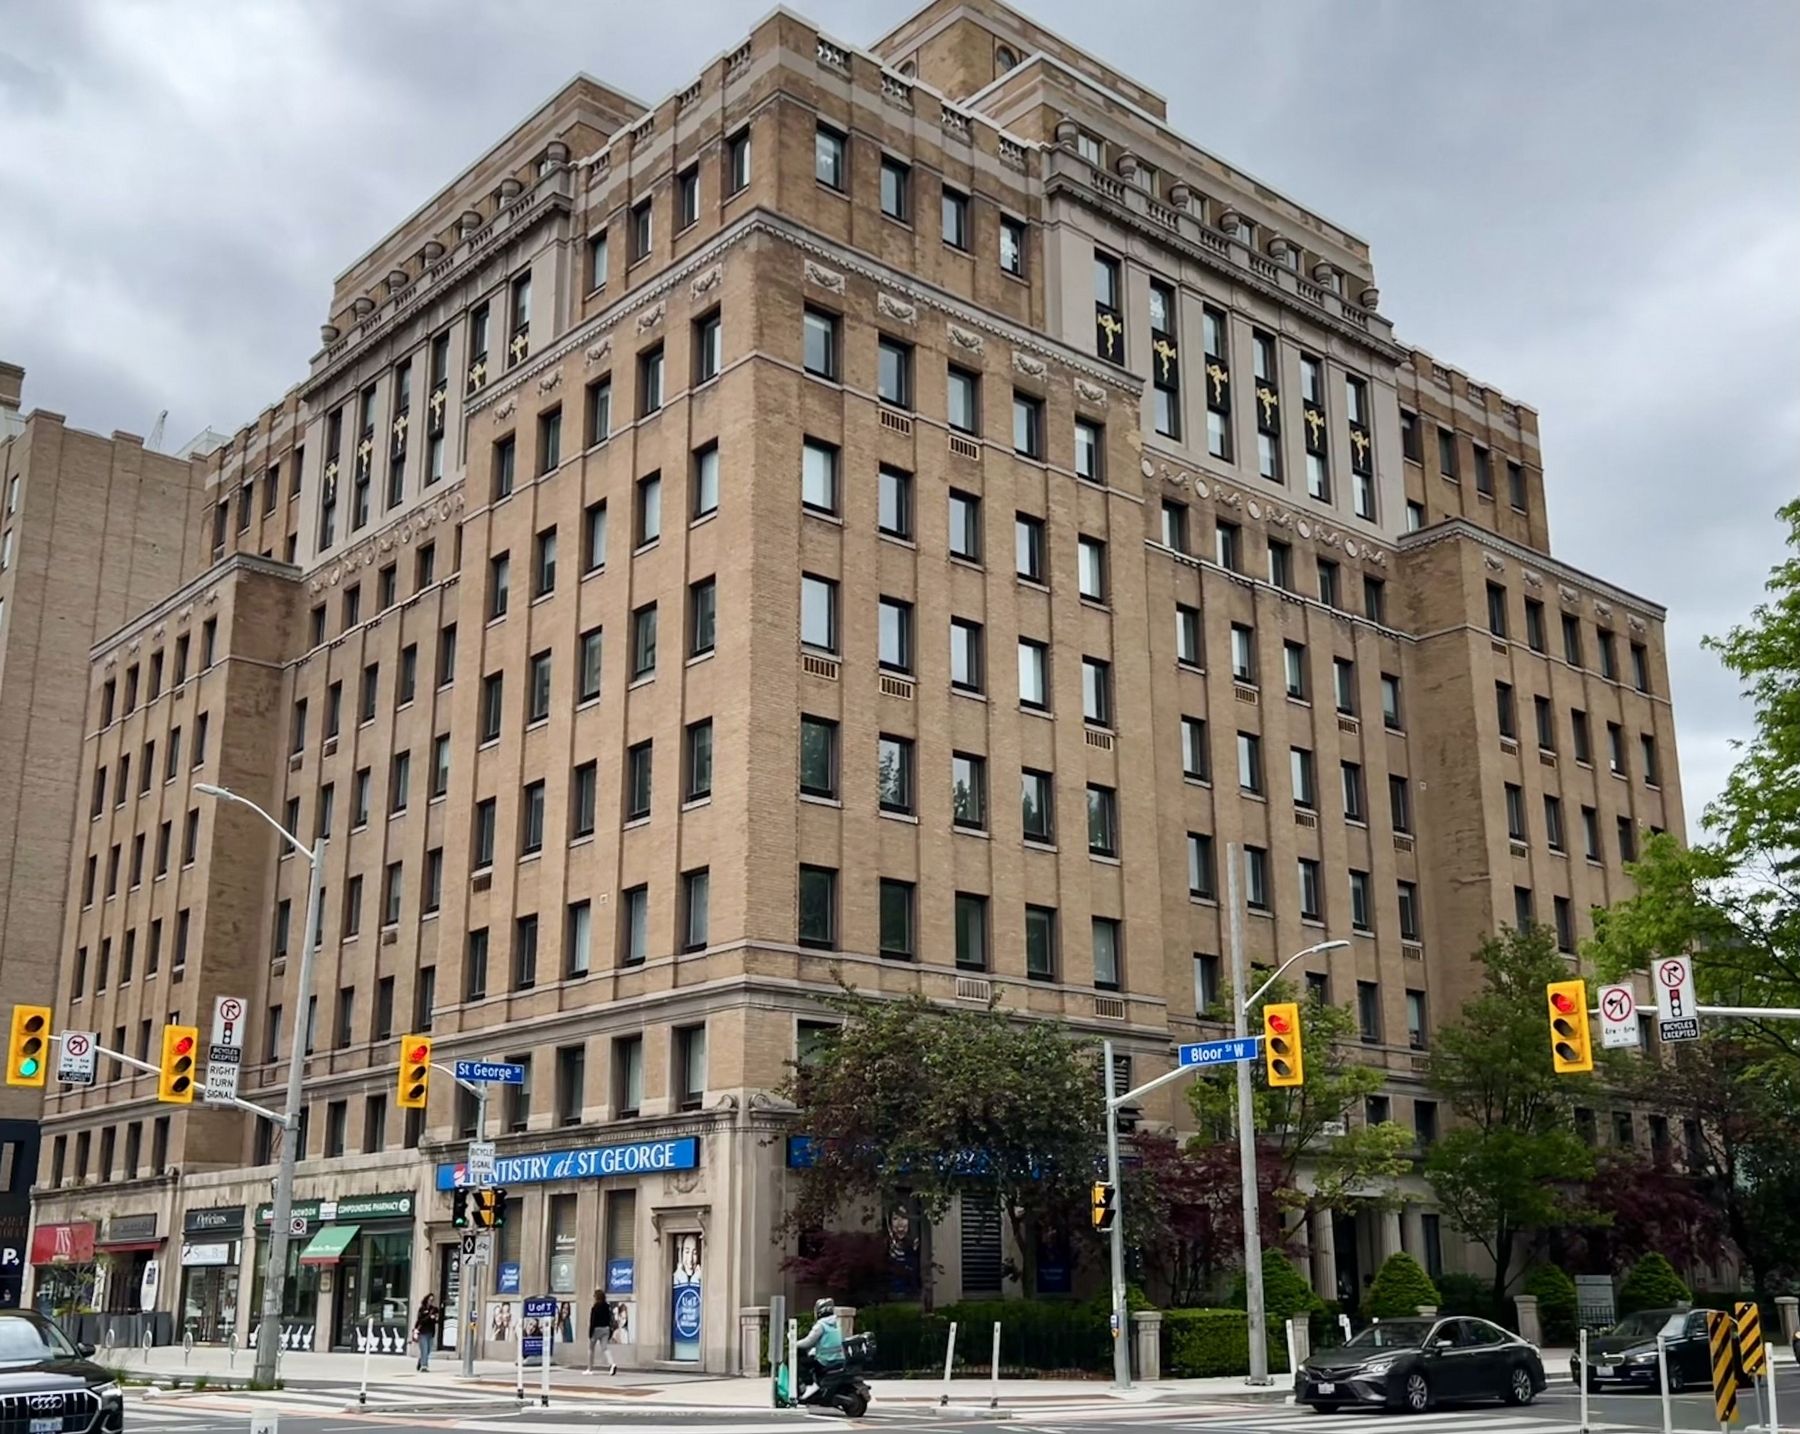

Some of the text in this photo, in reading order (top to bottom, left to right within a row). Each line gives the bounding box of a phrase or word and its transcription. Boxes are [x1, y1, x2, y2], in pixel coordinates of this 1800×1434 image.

[1663, 1021, 1694, 1031] BICYCLES
[1663, 1029, 1697, 1039] EXCEPTED
[1191, 1047, 1222, 1062] Bloor
[1233, 1043, 1244, 1057] W
[210, 1065, 236, 1075] RIGHT
[458, 1063, 470, 1075] St
[473, 1063, 512, 1081] George
[210, 1077, 234, 1088] TURN
[206, 1089, 234, 1100] SIGNAL
[471, 1148, 494, 1157] BICYCLE
[469, 1143, 676, 1185] NTISTRY at ST GEORGE
[471, 1160, 491, 1169] SIGNAL
[1, 1247, 17, 1266] P
[528, 1303, 535, 1312] U
[546, 1303, 552, 1311] T
